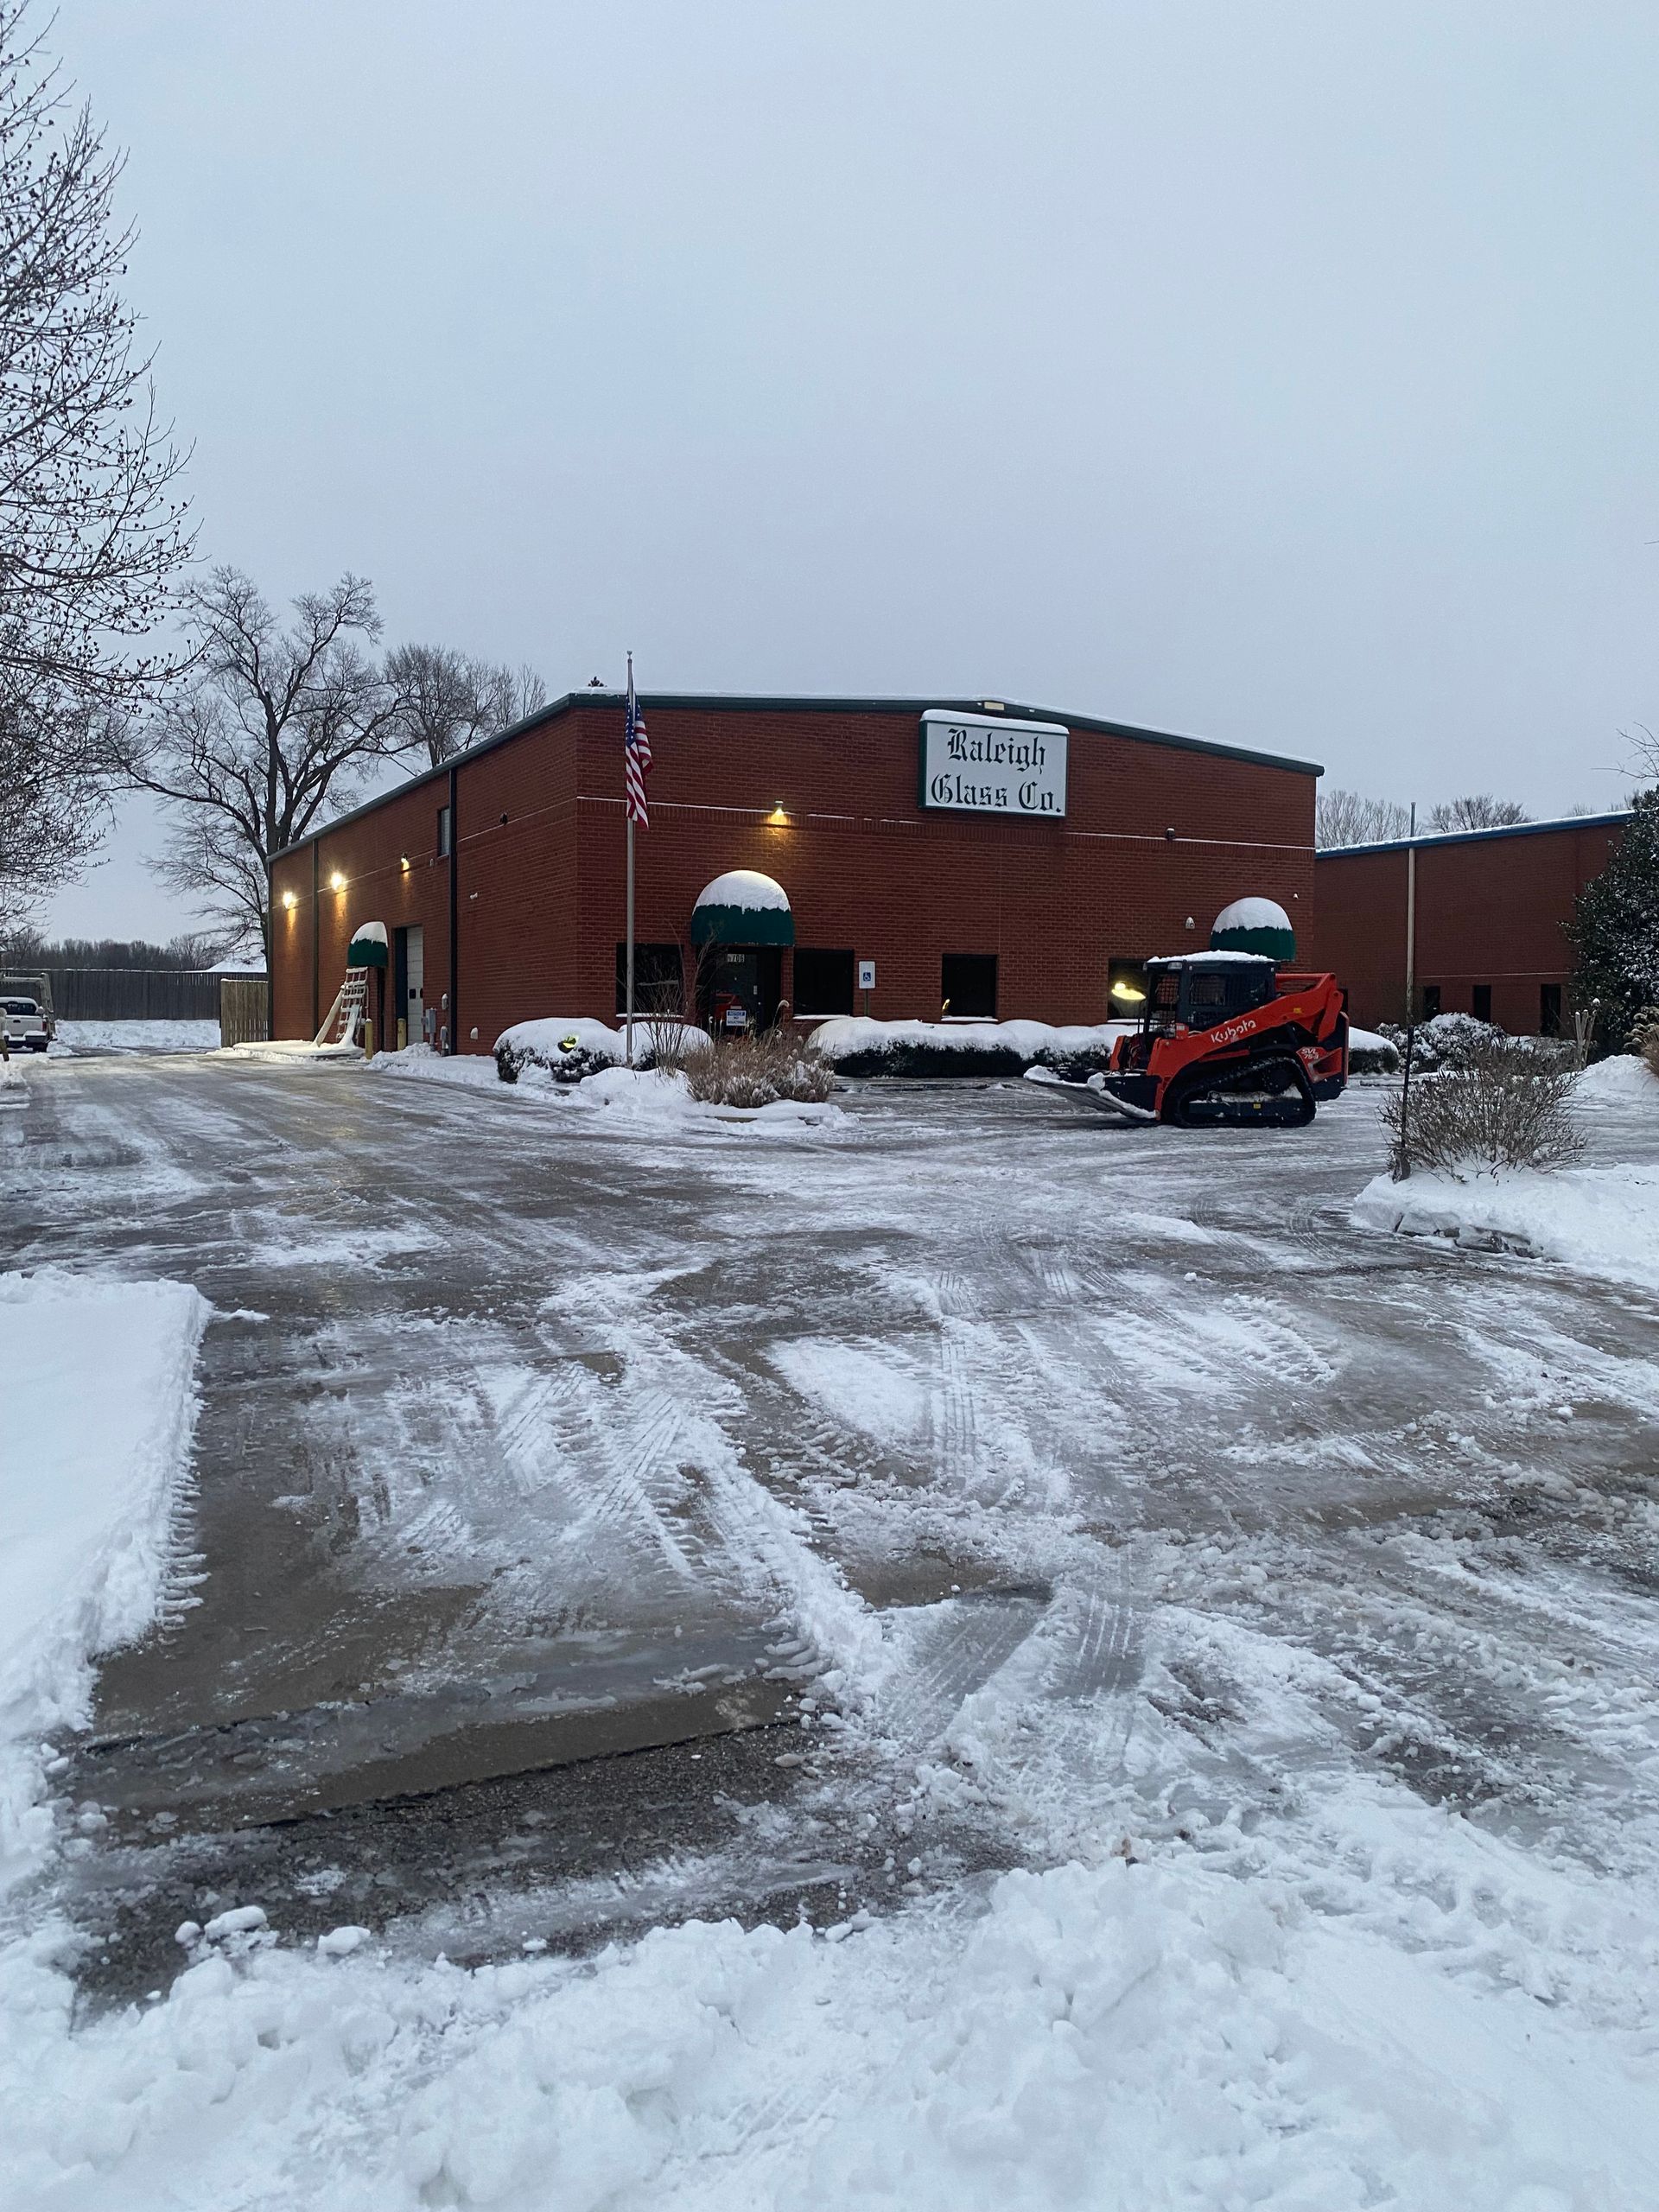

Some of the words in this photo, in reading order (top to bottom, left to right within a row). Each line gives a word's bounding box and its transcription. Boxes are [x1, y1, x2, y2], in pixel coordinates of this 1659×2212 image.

[947, 728, 1046, 774] Raleigh
[931, 773, 1007, 807] Glass
[1018, 781, 1062, 813] Co.
[1211, 1020, 1256, 1043] Kubota
